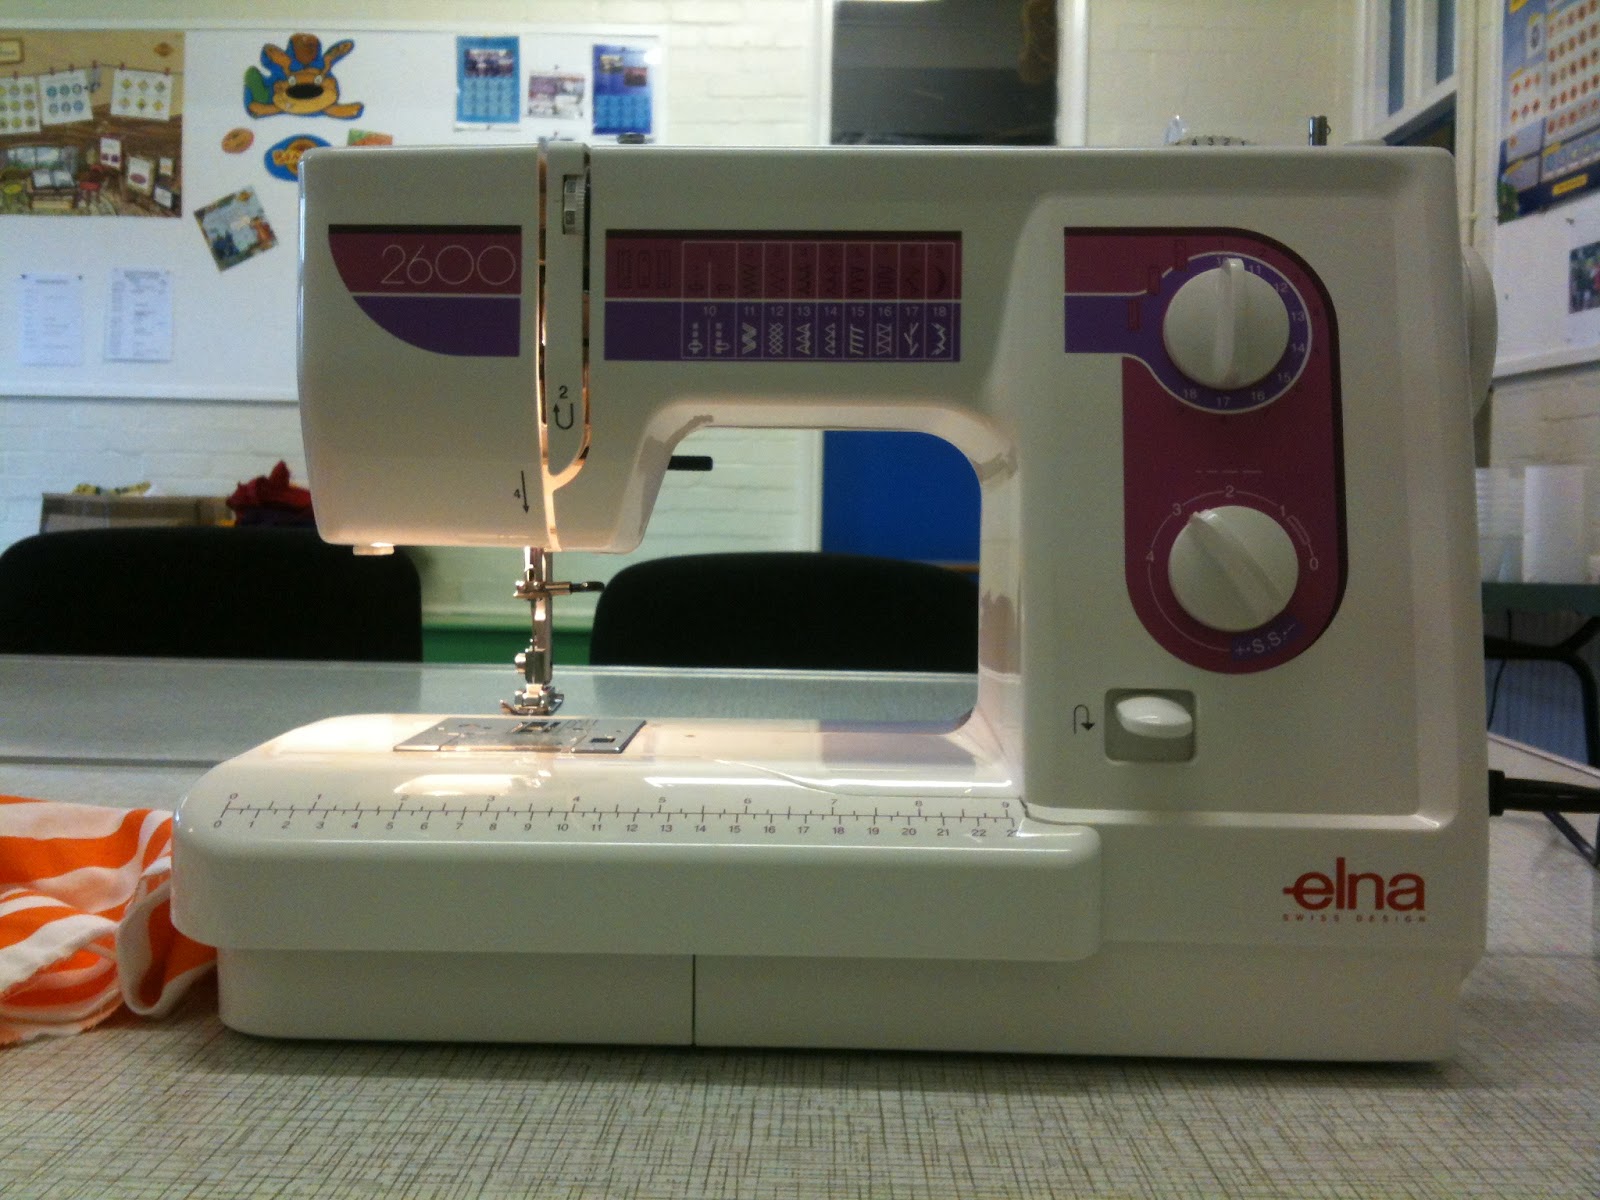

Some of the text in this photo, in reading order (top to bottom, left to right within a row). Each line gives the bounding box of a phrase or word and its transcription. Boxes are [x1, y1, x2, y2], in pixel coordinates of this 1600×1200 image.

[381, 245, 516, 285] 2600
[1249, 264, 1262, 275] 11
[1275, 281, 1288, 294] 12
[703, 305, 947, 317] 10 11 12 13 14 15 16 17 18
[1291, 311, 1305, 322] 13
[1291, 343, 1305, 353] 14
[1278, 372, 1291, 384] 15
[559, 385, 568, 399] 2
[1183, 387, 1198, 399] 18
[1252, 390, 1266, 401] 16
[1217, 396, 1231, 408] 17
[514, 489, 520, 499] 4
[1225, 485, 1234, 498] 2
[1172, 503, 1182, 516] 3
[1280, 505, 1286, 516] 1
[1146, 551, 1155, 562] 4
[1309, 557, 1319, 570] 0
[213, 820, 222, 828] 0
[281, 821, 290, 829] 2
[316, 821, 324, 829] 3
[386, 822, 393, 830] 5
[420, 822, 428, 830] 6
[456, 822, 463, 830] 7
[489, 823, 497, 831] 8
[524, 823, 532, 831] 9
[627, 824, 638, 832] 12
[729, 825, 741, 833] 15
[764, 826, 775, 834] 16
[798, 826, 810, 834] 17
[867, 827, 879, 835] 19
[902, 828, 917, 836] 20
[937, 828, 949, 836] 21
[971, 828, 986, 837] 22
[1007, 829, 1018, 837] 2
[1283, 857, 1425, 911] elna
[1283, 914, 1340, 922] SWISS
